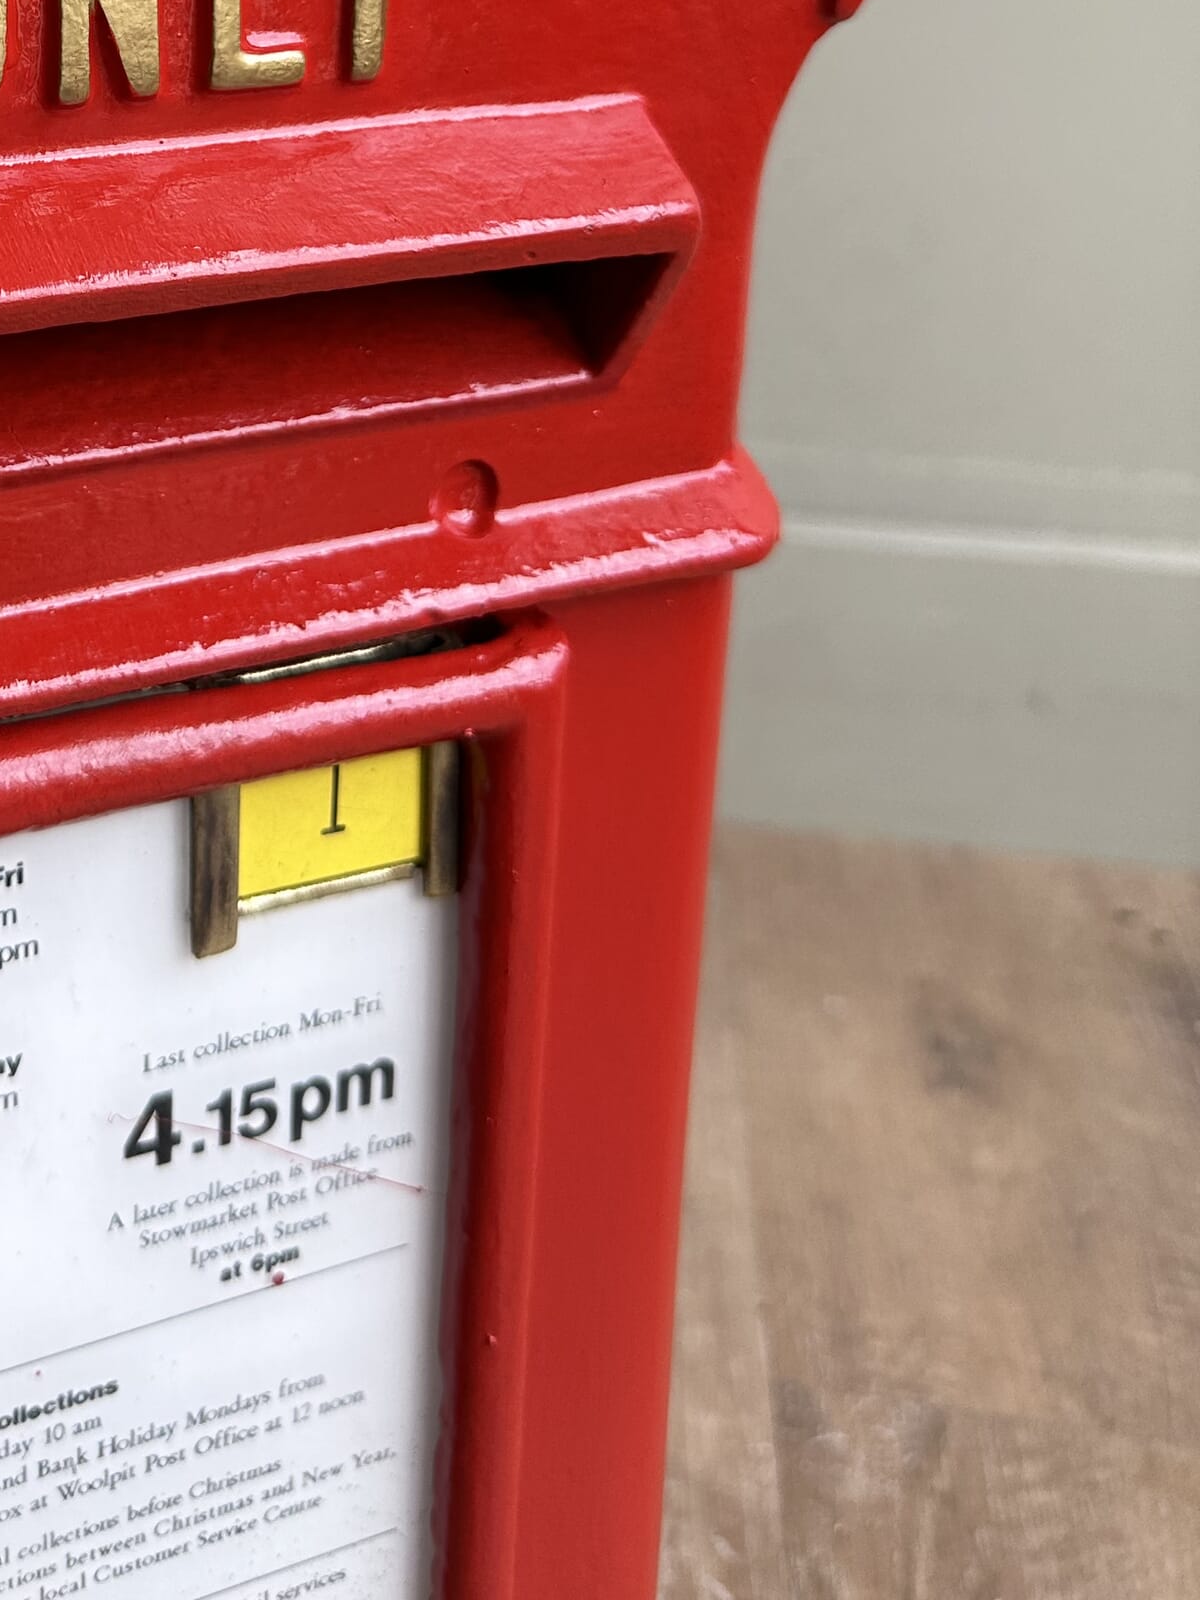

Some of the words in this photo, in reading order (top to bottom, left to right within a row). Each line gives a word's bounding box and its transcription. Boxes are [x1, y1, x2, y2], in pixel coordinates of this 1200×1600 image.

[142, 1050, 186, 1073] Last
[193, 1020, 291, 1061] collection
[298, 992, 383, 1033] Mon-Fri
[123, 1055, 396, 1166] 4.15pm
[107, 1211, 124, 1233] A
[133, 1199, 177, 1225] later
[184, 1167, 282, 1210] collection
[288, 1158, 304, 1182] is
[311, 1142, 360, 1175] made
[367, 1131, 413, 1157] from
[138, 1202, 259, 1249] Stowmarket
[267, 1190, 308, 1213] Post
[314, 1167, 378, 1196] Office
[190, 1227, 267, 1269] Ipswich
[274, 1211, 329, 1240] Street
[220, 1263, 242, 1283] at
[251, 1245, 301, 1275] 6pm
[30, 1494, 49, 1512] at
[56, 1461, 136, 1501] Woolpit
[144, 1447, 187, 1476] Post
[193, 1423, 260, 1457] Office
[264, 1416, 283, 1433] at
[291, 1401, 313, 1424] 12
[318, 1389, 366, 1415] noon
[36, 1445, 89, 1479] Bank
[96, 1420, 177, 1459] Holiday
[184, 1391, 271, 1430] Mondays
[278, 1372, 327, 1399] from
[44, 1422, 67, 1445] 10
[72, 1415, 103, 1435] am
[17, 1513, 121, 1560] collections
[127, 1492, 183, 1522] before
[188, 1458, 283, 1501] Christmas
[39, 1570, 87, 1600] local
[93, 1540, 191, 1584] Customer
[196, 1516, 258, 1548] Service
[262, 1494, 324, 1523] Centre
[65, 1531, 146, 1569] between
[153, 1494, 254, 1537] Christmas
[261, 1474, 294, 1500] and
[302, 1461, 344, 1488] New
[276, 1568, 346, 1600] services
